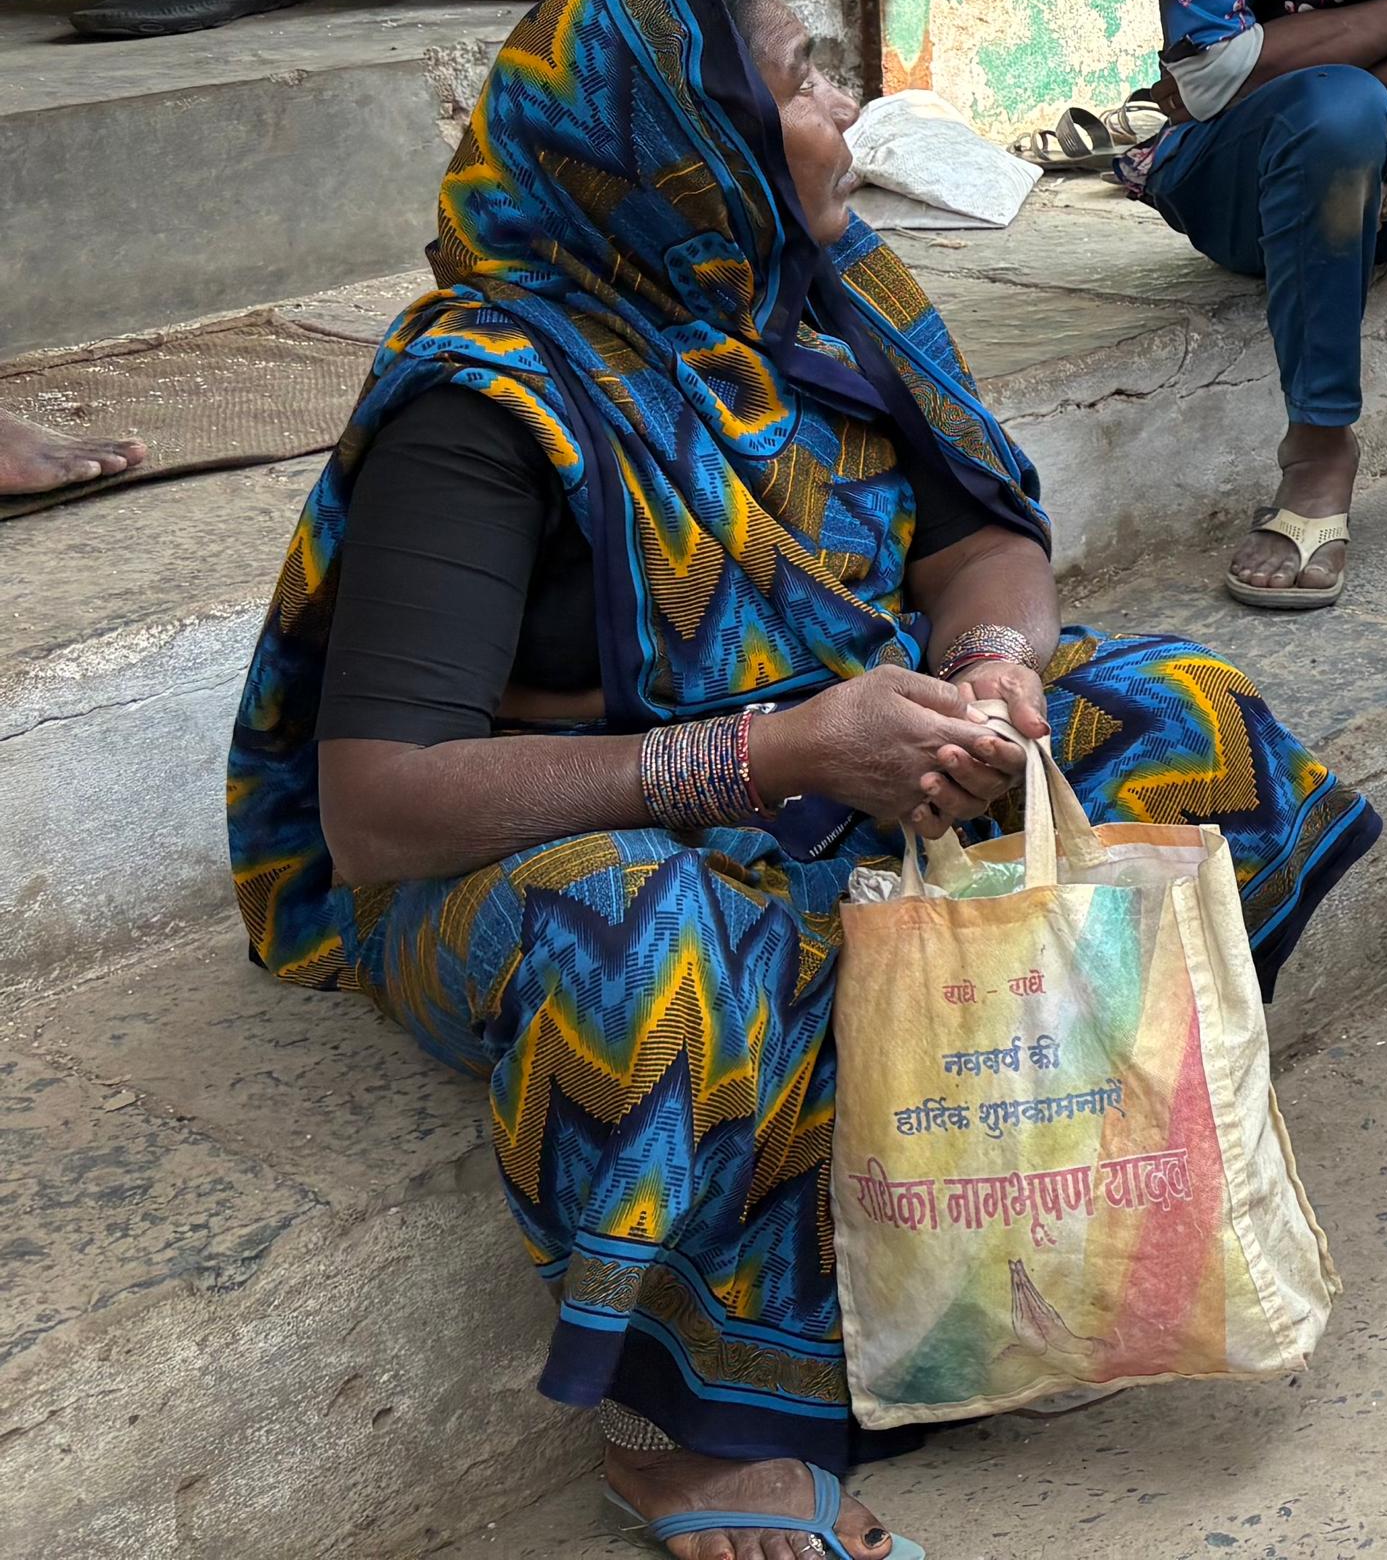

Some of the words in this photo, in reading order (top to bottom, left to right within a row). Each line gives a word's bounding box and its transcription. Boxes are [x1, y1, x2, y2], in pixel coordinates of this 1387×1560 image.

[942, 978, 977, 1005] राधे
[1008, 968, 1046, 997] राधे
[941, 1035, 1022, 1077] नववर्ष
[1027, 1034, 1061, 1070] की
[893, 1096, 971, 1136] हार्दिक
[848, 1155, 940, 1232] राधिका
[943, 1163, 1095, 1248] नागभूषण
[1099, 1148, 1193, 1212] यादव
